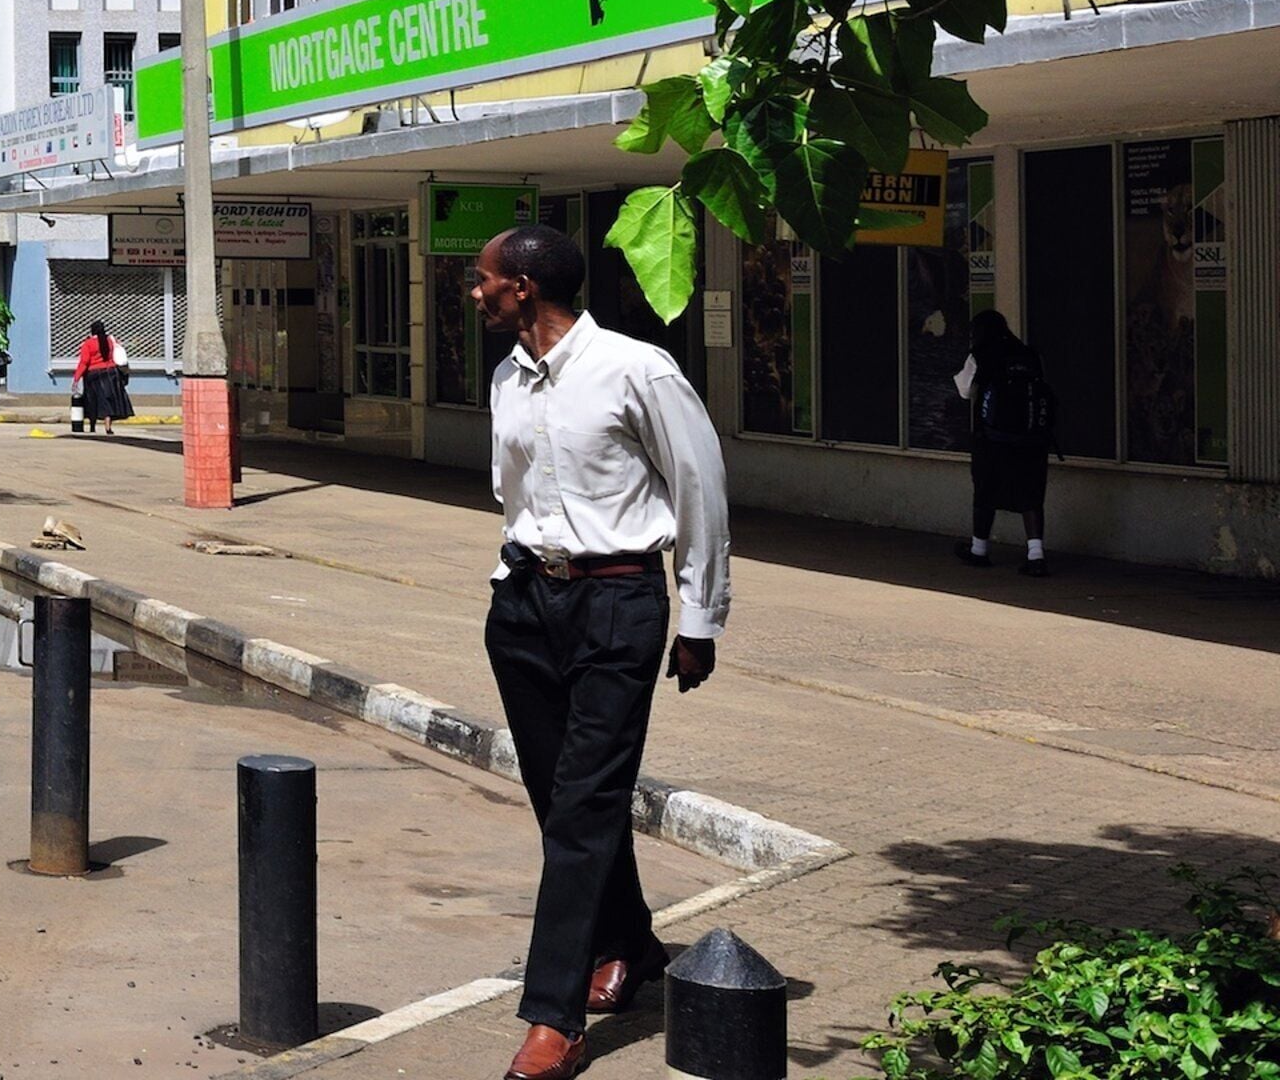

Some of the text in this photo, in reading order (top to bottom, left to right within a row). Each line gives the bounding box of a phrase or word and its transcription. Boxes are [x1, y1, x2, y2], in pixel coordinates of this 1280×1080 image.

[269, 15, 385, 92] MORTGAGE
[77, 93, 94, 117] LTD
[859, 188, 913, 202] NION
[250, 206, 285, 216] TECH
[286, 207, 309, 217] LTD
[460, 201, 484, 212] KCB
[219, 217, 237, 228] For
[240, 217, 255, 226] the
[971, 255, 994, 270] S&L
[1195, 247, 1226, 264] S&L
